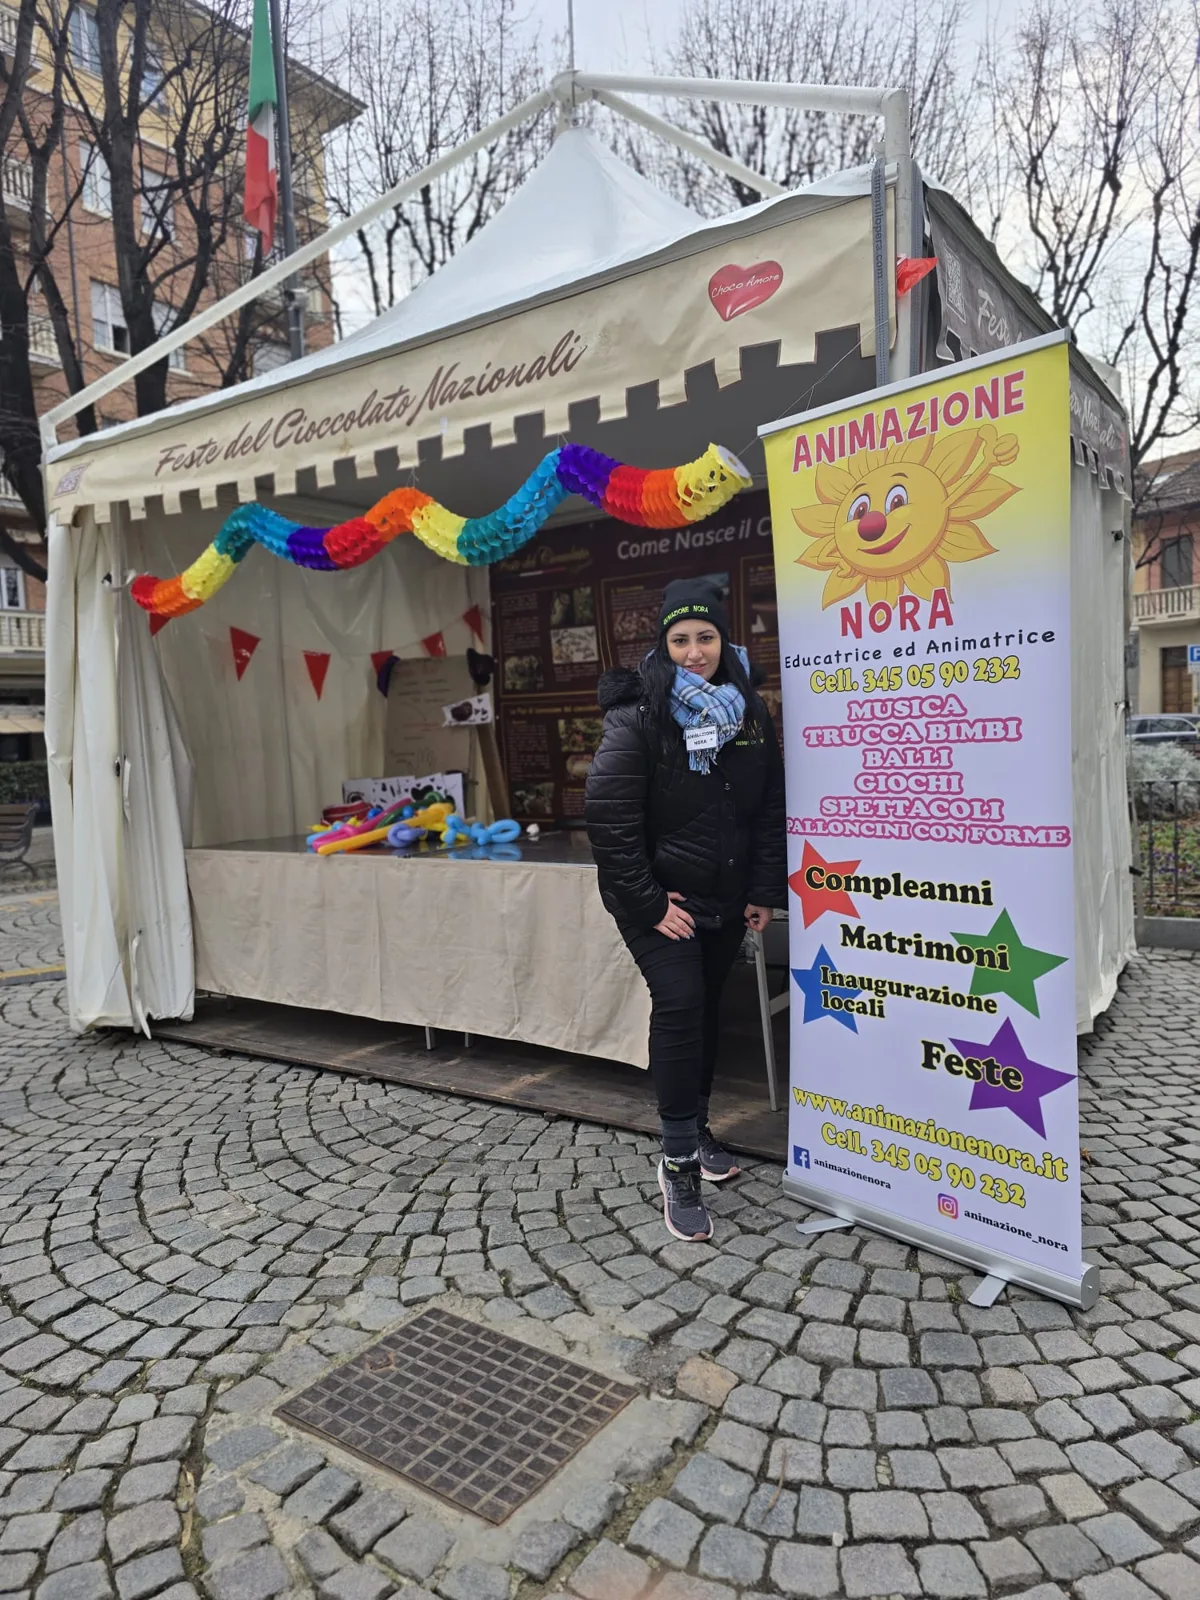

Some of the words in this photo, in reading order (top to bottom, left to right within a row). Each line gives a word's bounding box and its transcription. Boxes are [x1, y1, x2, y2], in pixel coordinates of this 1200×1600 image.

[155, 437, 222, 476] Feste
[224, 417, 273, 460] del
[273, 384, 416, 449] Cioccolato
[406, 330, 588, 427] Nazionali
[792, 370, 1026, 473] ANIMAZIONE
[617, 537, 670, 560] Come
[675, 525, 736, 551] Nasce
[738, 518, 752, 540] il
[693, 605, 709, 613] NORA
[840, 587, 955, 639] NORA
[785, 647, 882, 669] Educatrice
[893, 641, 916, 657] ed
[926, 628, 1056, 654] Animatrice
[810, 667, 859, 694] Cell.
[862, 666, 903, 693] 345
[907, 663, 935, 688] 05
[939, 660, 969, 687] 90
[973, 655, 1020, 683] 232
[847, 694, 967, 722] MUSICA
[803, 722, 924, 747] TRUCCA
[925, 717, 1023, 742] BIMBI
[862, 746, 953, 770] BALLI
[854, 771, 964, 796] GIOCHI
[819, 796, 1005, 822] SPETTACOLI
[786, 817, 912, 840] PALLONCINI
[912, 821, 967, 844] CON
[968, 824, 1071, 847] FORME
[805, 865, 993, 906] Compleanni
[840, 923, 1011, 971] Matrimoni
[820, 965, 998, 1014] Inaugurazione
[821, 990, 886, 1019] locali
[921, 1039, 1024, 1091] Feste
[792, 1087, 1069, 1182] www.animazionenora.it
[814, 1157, 892, 1190] animazionenora
[821, 1122, 868, 1156] Cell.
[871, 1140, 910, 1171] 345
[914, 1153, 943, 1181] 05
[946, 1163, 975, 1190] 90
[979, 1174, 1027, 1208] 232
[964, 1208, 1069, 1252] animazione_nora
